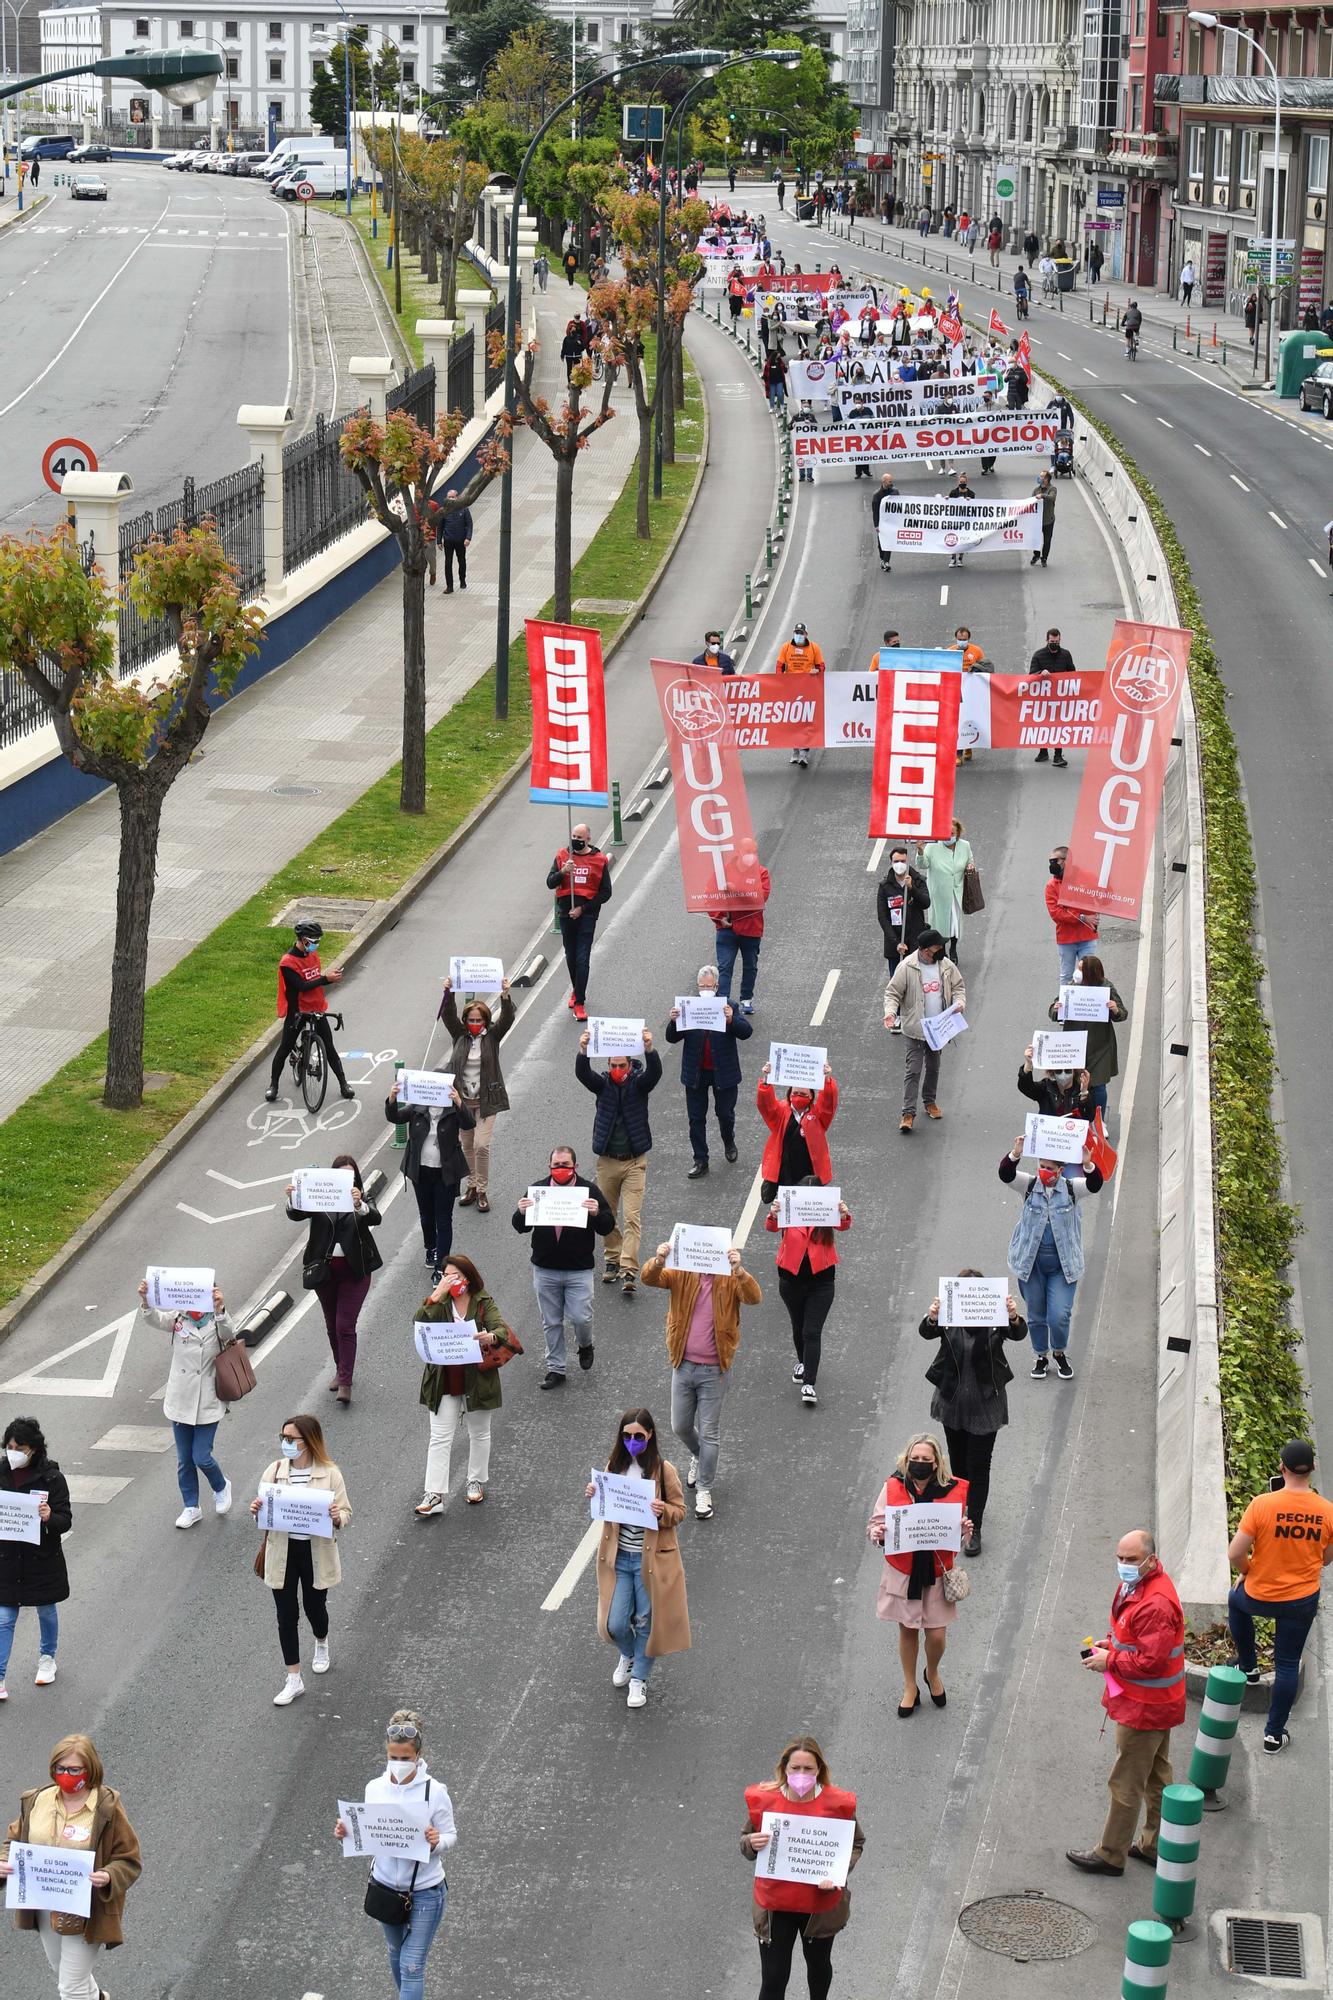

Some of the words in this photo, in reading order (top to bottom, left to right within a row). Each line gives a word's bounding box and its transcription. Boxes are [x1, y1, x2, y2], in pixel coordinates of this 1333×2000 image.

[842, 388, 912, 404] Pensións
[924, 383, 975, 399] Dignas
[876, 403, 908, 418] NON
[796, 425, 818, 433] POR
[822, 423, 856, 432] UNHA
[860, 420, 901, 430] TARIFA
[905, 416, 973, 428] ELÉCTRICA
[977, 412, 1059, 423] COMPETITIVA
[795, 429, 907, 456] ENERXÍA
[916, 421, 1058, 448] SOLUCIÓN
[849, 455, 888, 463] SINDICAL
[1002, 444, 1033, 453] SABÓN
[52, 458, 85, 476] 40
[885, 502, 902, 514] NON
[904, 503, 921, 515] AOS
[924, 504, 994, 518] DESPEDIMENTOS
[996, 507, 1006, 518] EN
[904, 518, 938, 530] (ANTIGO
[941, 519, 970, 531] GRUPO
[1122, 654, 1170, 682] UGT
[1018, 681, 1051, 697] POR
[1057, 679, 1081, 696] UN
[673, 688, 713, 712] UGT
[727, 696, 816, 724] EPRESIÓN
[1018, 699, 1102, 723] FUTURO
[843, 722, 871, 738] CIG
[885, 671, 941, 837] CCOO
[1094, 713, 1154, 888] UGT
[682, 742, 734, 891] UGT
[1067, 884, 1136, 905] www.ugtgalicia.org
[1276, 1513, 1323, 1525] PECHE
[1275, 1525, 1322, 1542] NON
[788, 1837, 840, 1848] TRABALLADOR
[788, 1856, 834, 1867] TRANSPORTE
[789, 1847, 822, 1856] ESENCIAL
[825, 1850, 836, 1858] DO
[31, 1867, 84, 1877] TRABALLADORA
[36, 1876, 68, 1885] ESENCIAL
[791, 1867, 828, 1876] SANITARIO
[42, 1886, 74, 1894] SANIDADE
